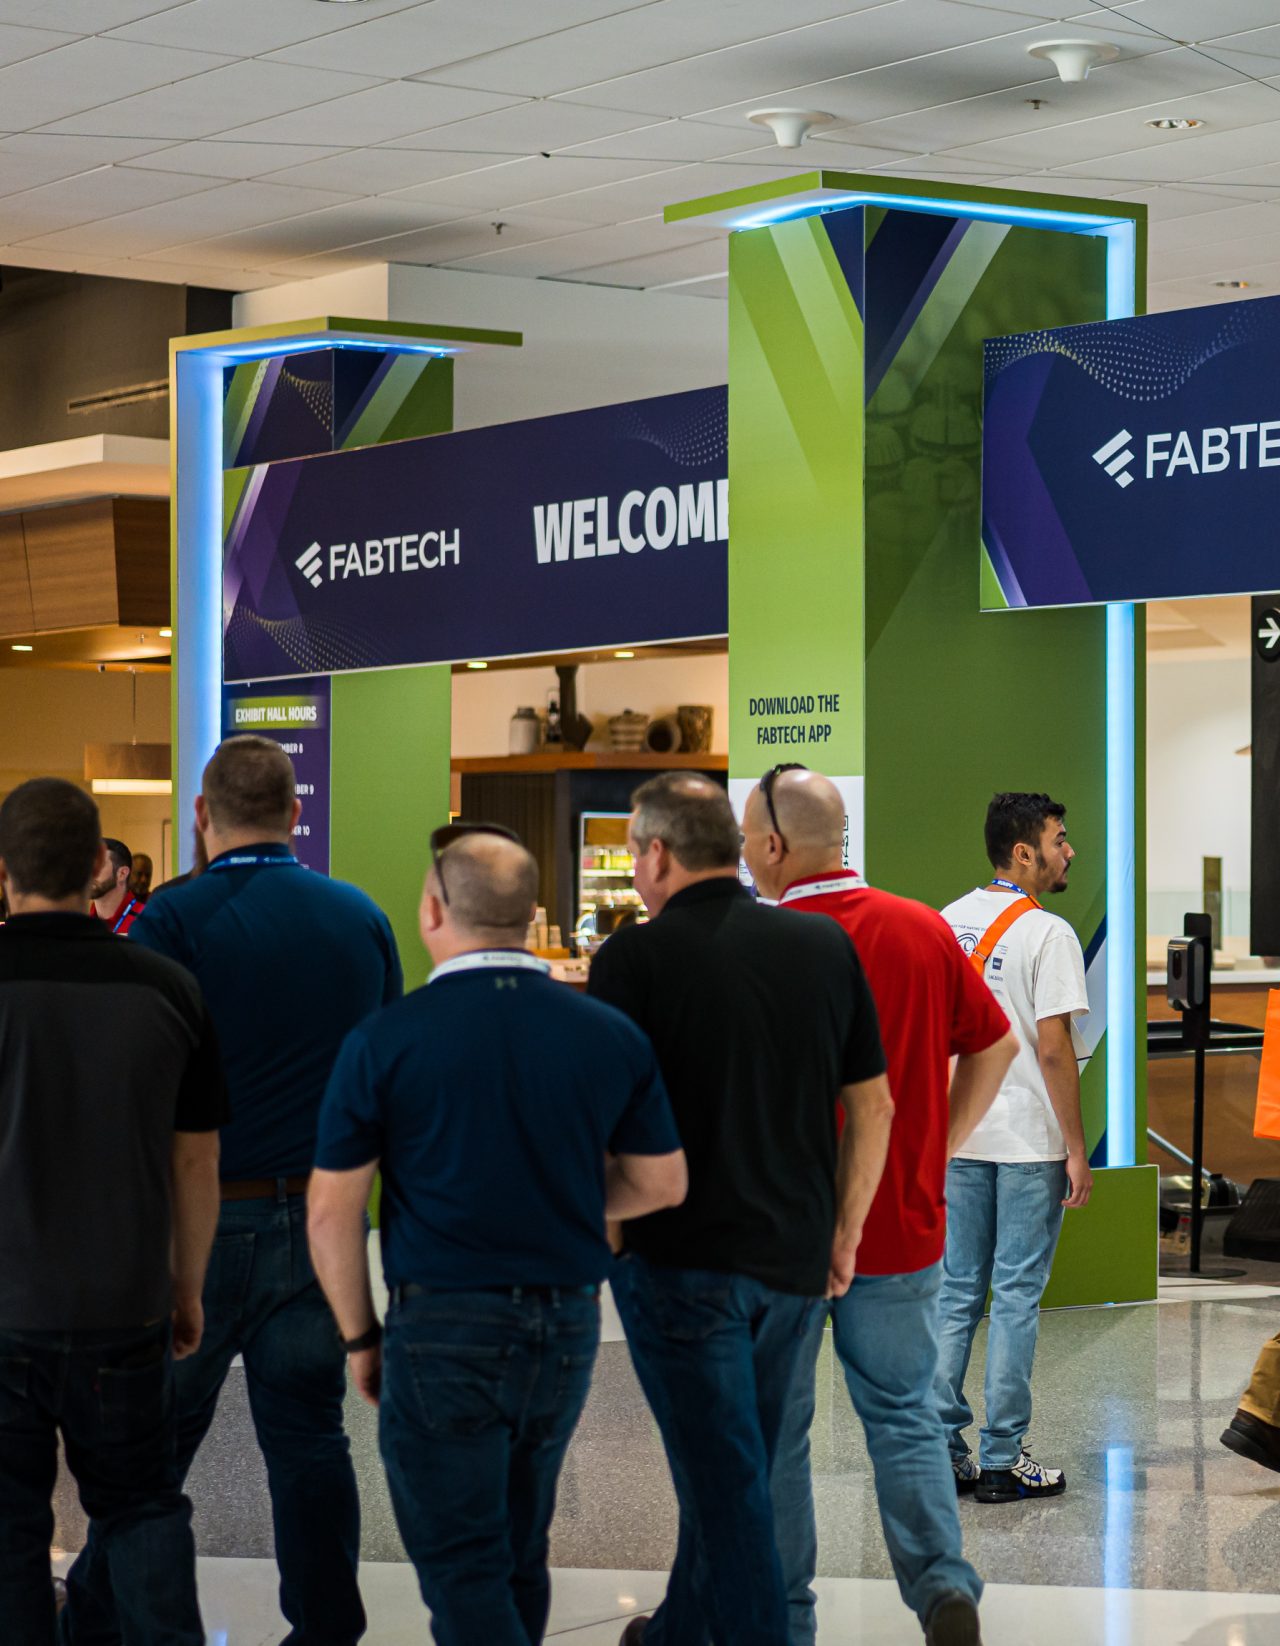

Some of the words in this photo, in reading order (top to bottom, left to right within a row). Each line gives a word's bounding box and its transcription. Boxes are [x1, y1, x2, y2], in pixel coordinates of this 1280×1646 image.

[329, 528, 460, 580] FABTECH
[235, 707, 266, 723] EXHIBIT
[267, 707, 287, 722] HALL
[288, 706, 317, 722] HOURS
[749, 696, 815, 716] DOWNLOAD
[817, 694, 840, 713] THE
[757, 725, 805, 744] FABTECH
[808, 724, 831, 743] APP
[303, 825, 310, 836] 10
